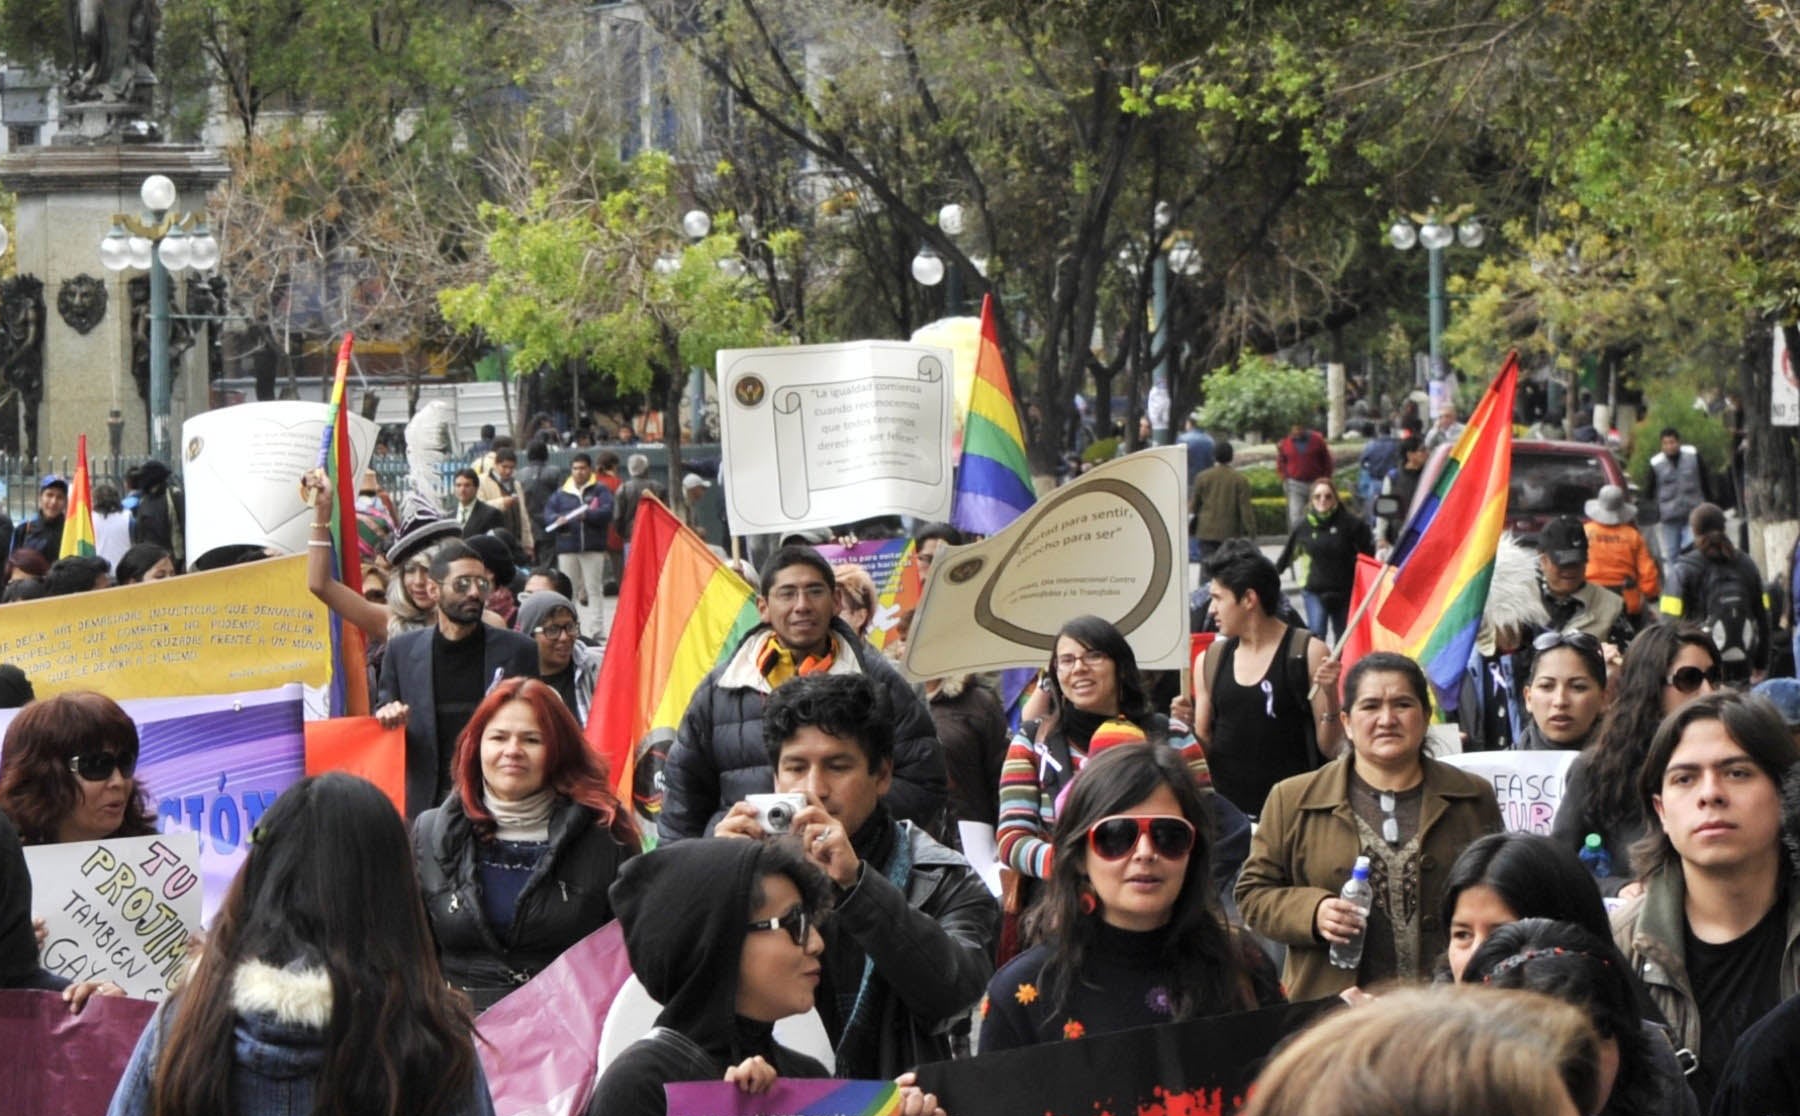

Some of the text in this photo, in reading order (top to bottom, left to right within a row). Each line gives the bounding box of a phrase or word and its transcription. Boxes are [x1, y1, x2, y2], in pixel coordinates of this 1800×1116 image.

[1061, 506, 1134, 532] para sentir,
[1062, 531, 1092, 546] para
[226, 604, 249, 616] QUE
[210, 634, 253, 647] FRENTE
[139, 840, 199, 901] TU
[62, 889, 148, 979] TAMBIEN
[43, 937, 107, 983] GAY
